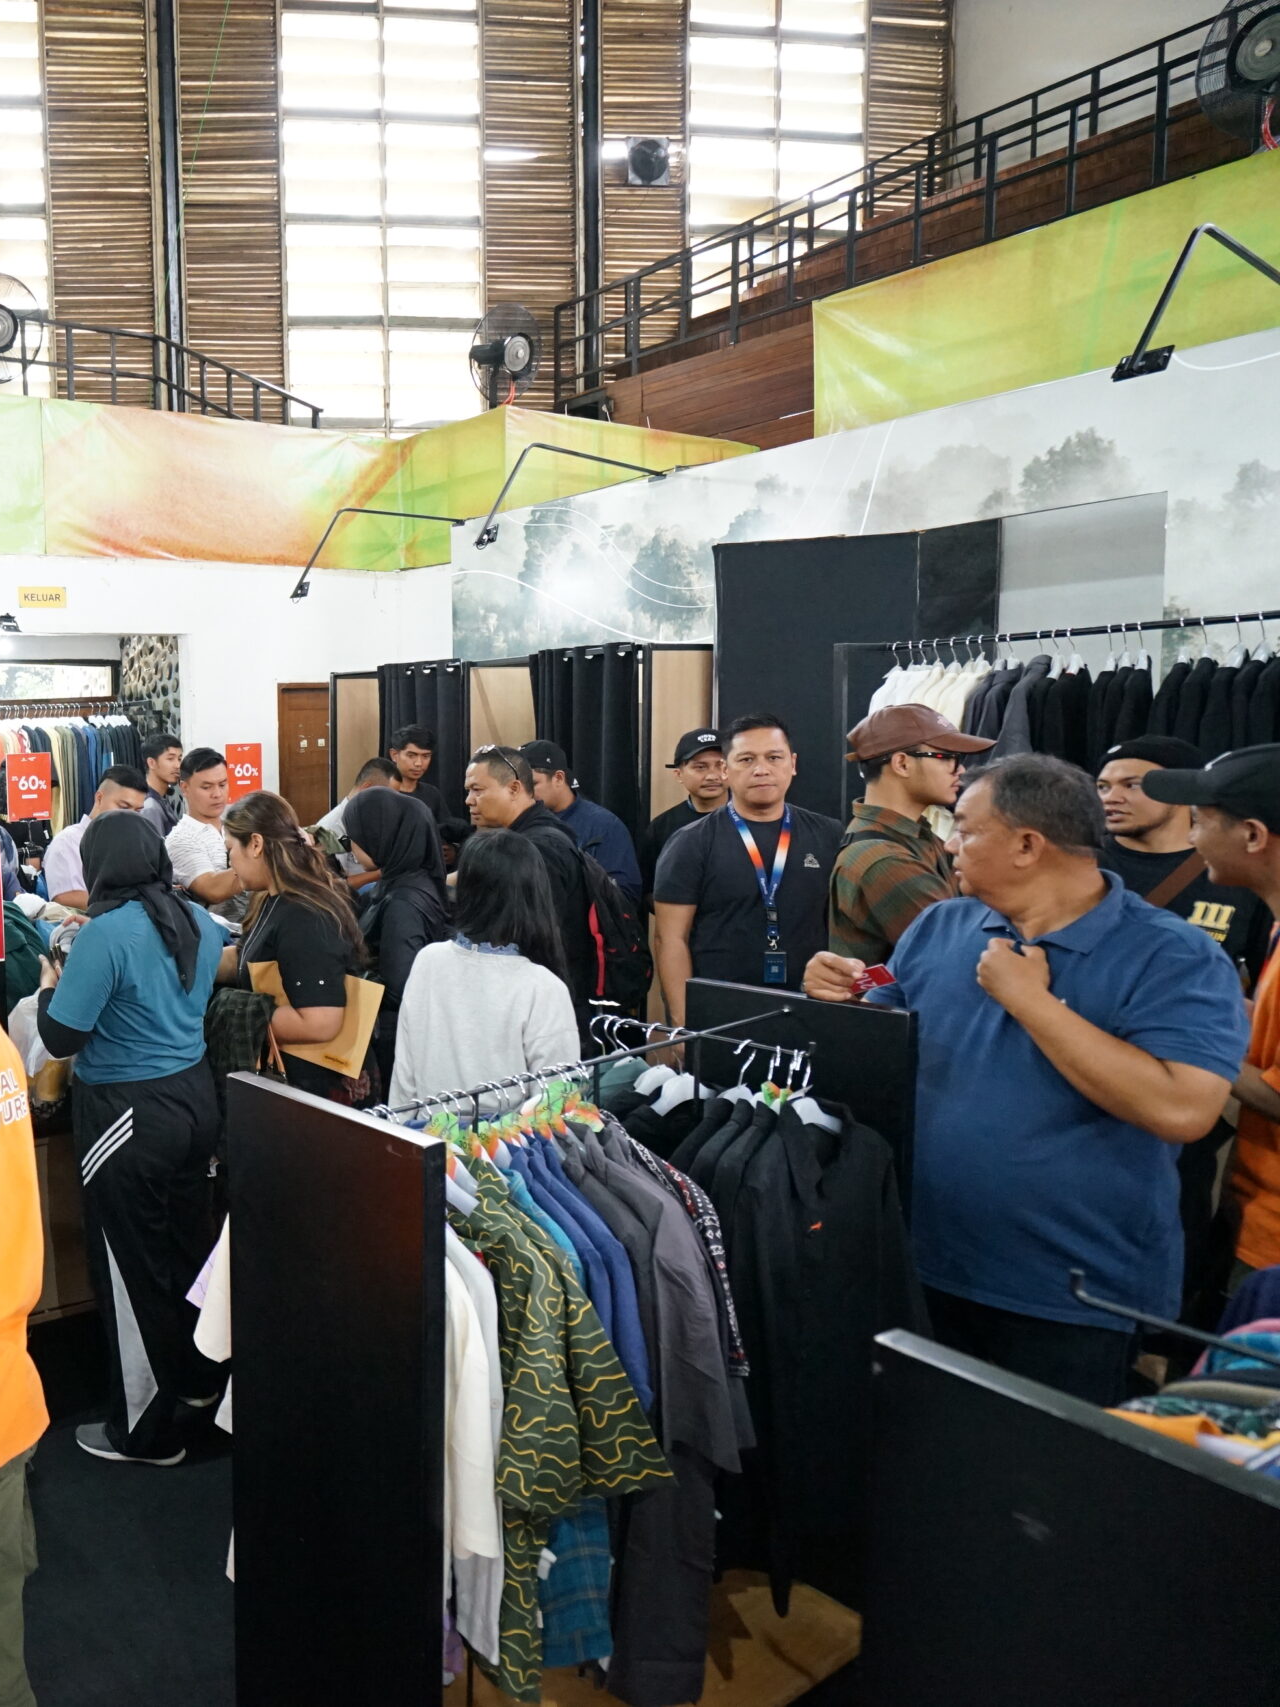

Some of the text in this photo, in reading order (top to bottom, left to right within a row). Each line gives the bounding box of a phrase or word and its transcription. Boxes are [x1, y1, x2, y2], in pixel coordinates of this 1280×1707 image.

[23, 592, 61, 602] KELUAR
[234, 763, 259, 777] 60%
[18, 775, 47, 791] 60%
